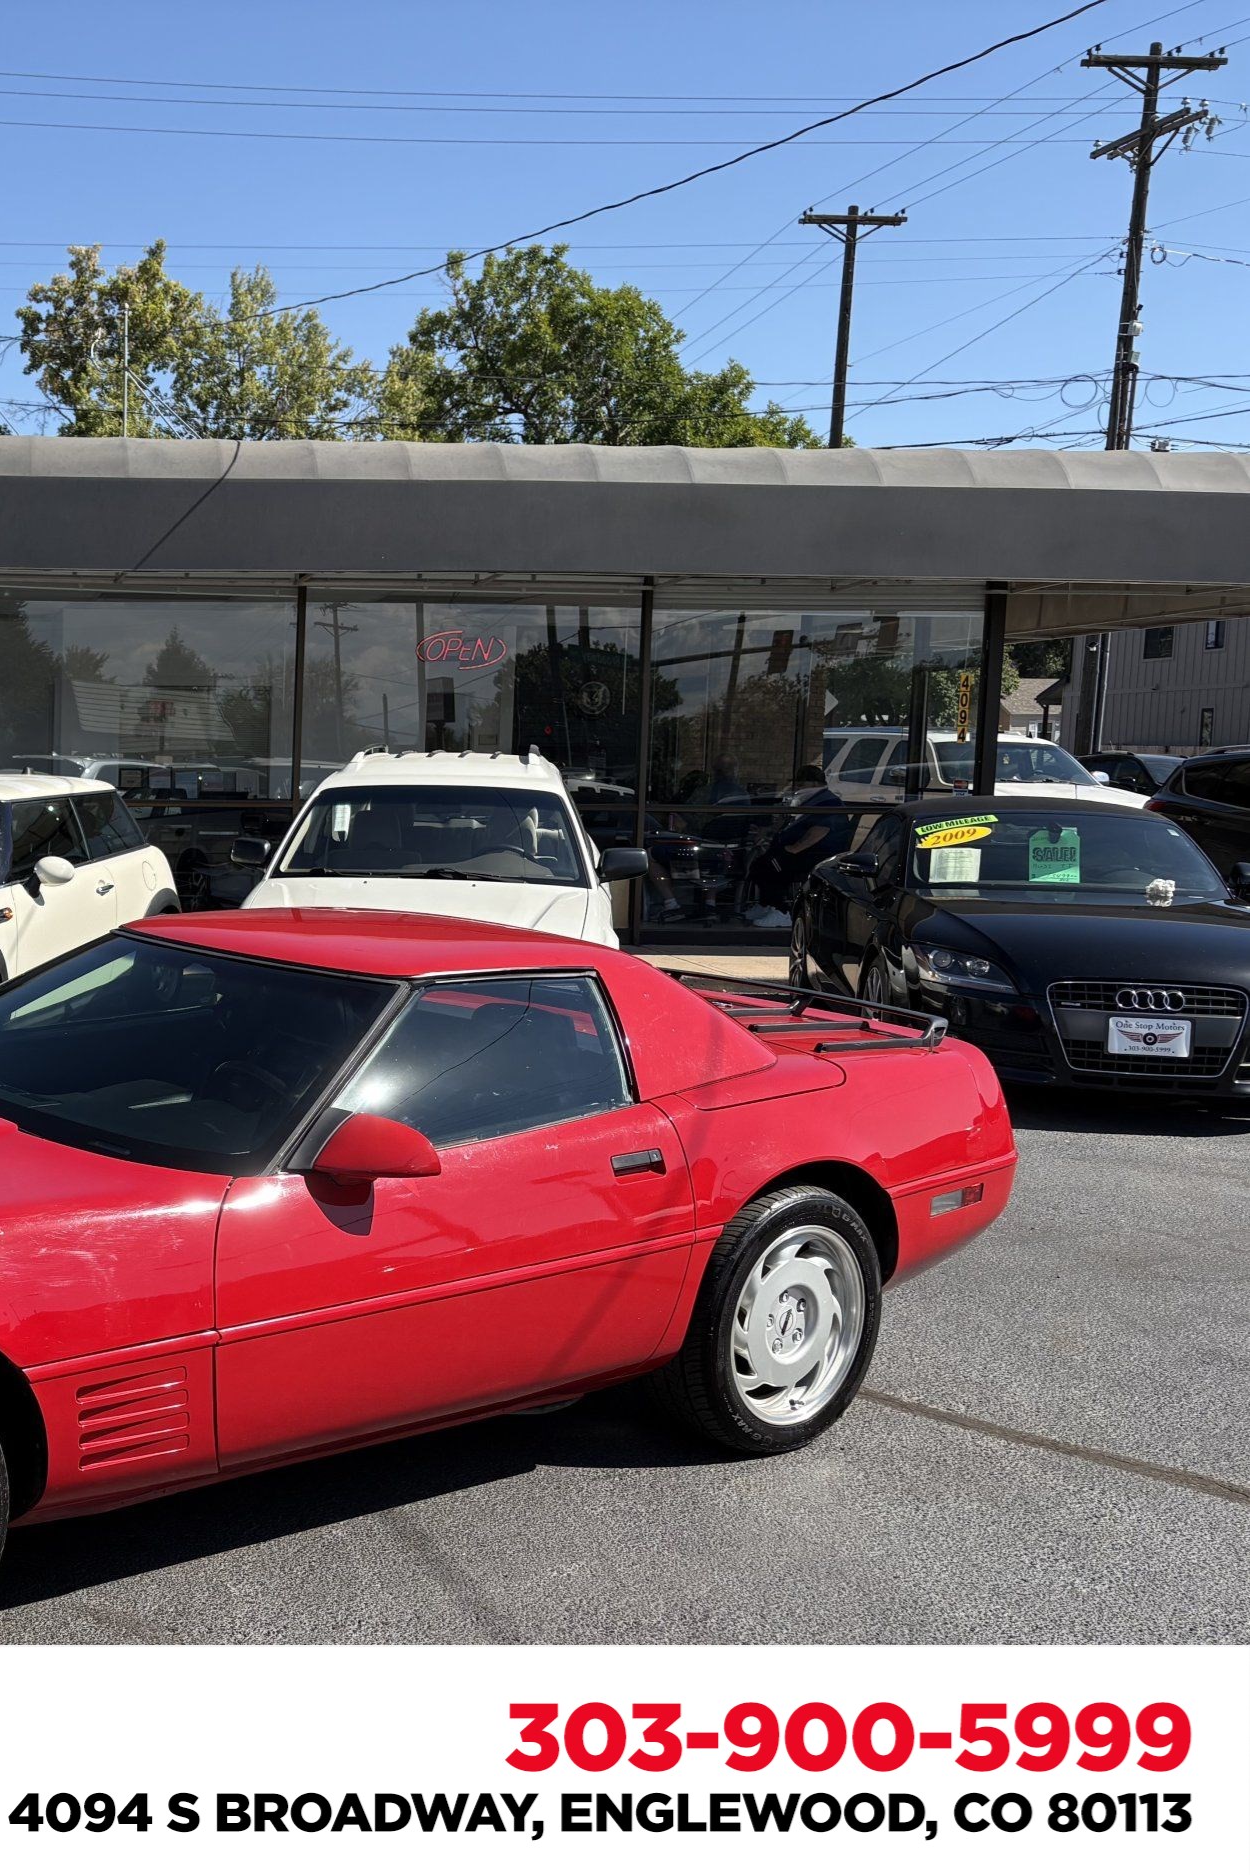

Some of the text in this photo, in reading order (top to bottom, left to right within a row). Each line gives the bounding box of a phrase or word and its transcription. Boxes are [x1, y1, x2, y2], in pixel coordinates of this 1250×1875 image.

[426, 637, 495, 661] OPEN
[957, 675, 970, 742] 4094
[921, 816, 992, 833] LOW MILEAGE
[930, 828, 978, 846] 2009
[1115, 1020, 1185, 1031] One Stop Motors
